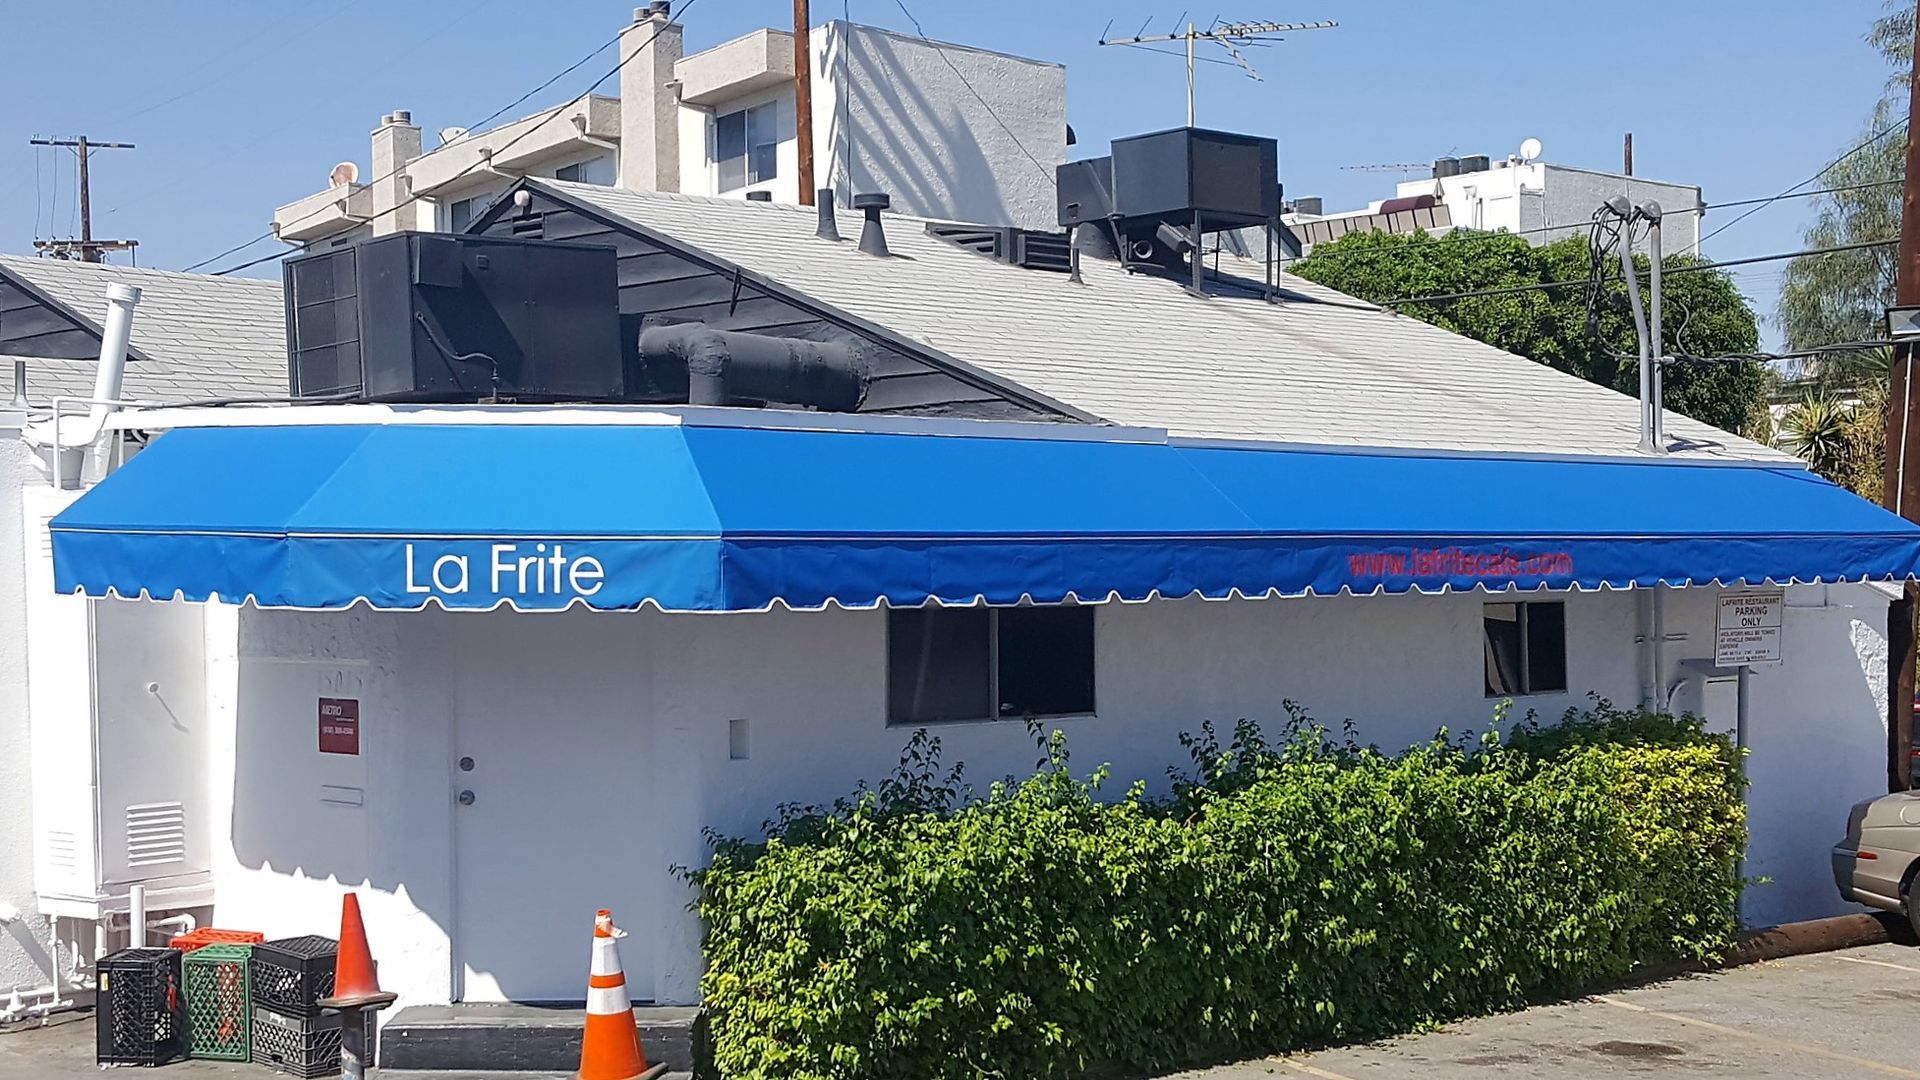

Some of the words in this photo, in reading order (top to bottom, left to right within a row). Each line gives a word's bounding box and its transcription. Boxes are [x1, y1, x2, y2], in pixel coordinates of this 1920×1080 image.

[1348, 545, 1573, 577] www.lafritecafe.com
[405, 543, 469, 594] La
[491, 543, 605, 595] Frite
[1722, 598, 1743, 606] LAFRITE
[1745, 597, 1779, 605] RESTAURANT
[1735, 606, 1767, 616] PARKING
[1741, 617, 1761, 626] ONLY
[321, 705, 342, 716] METRO
